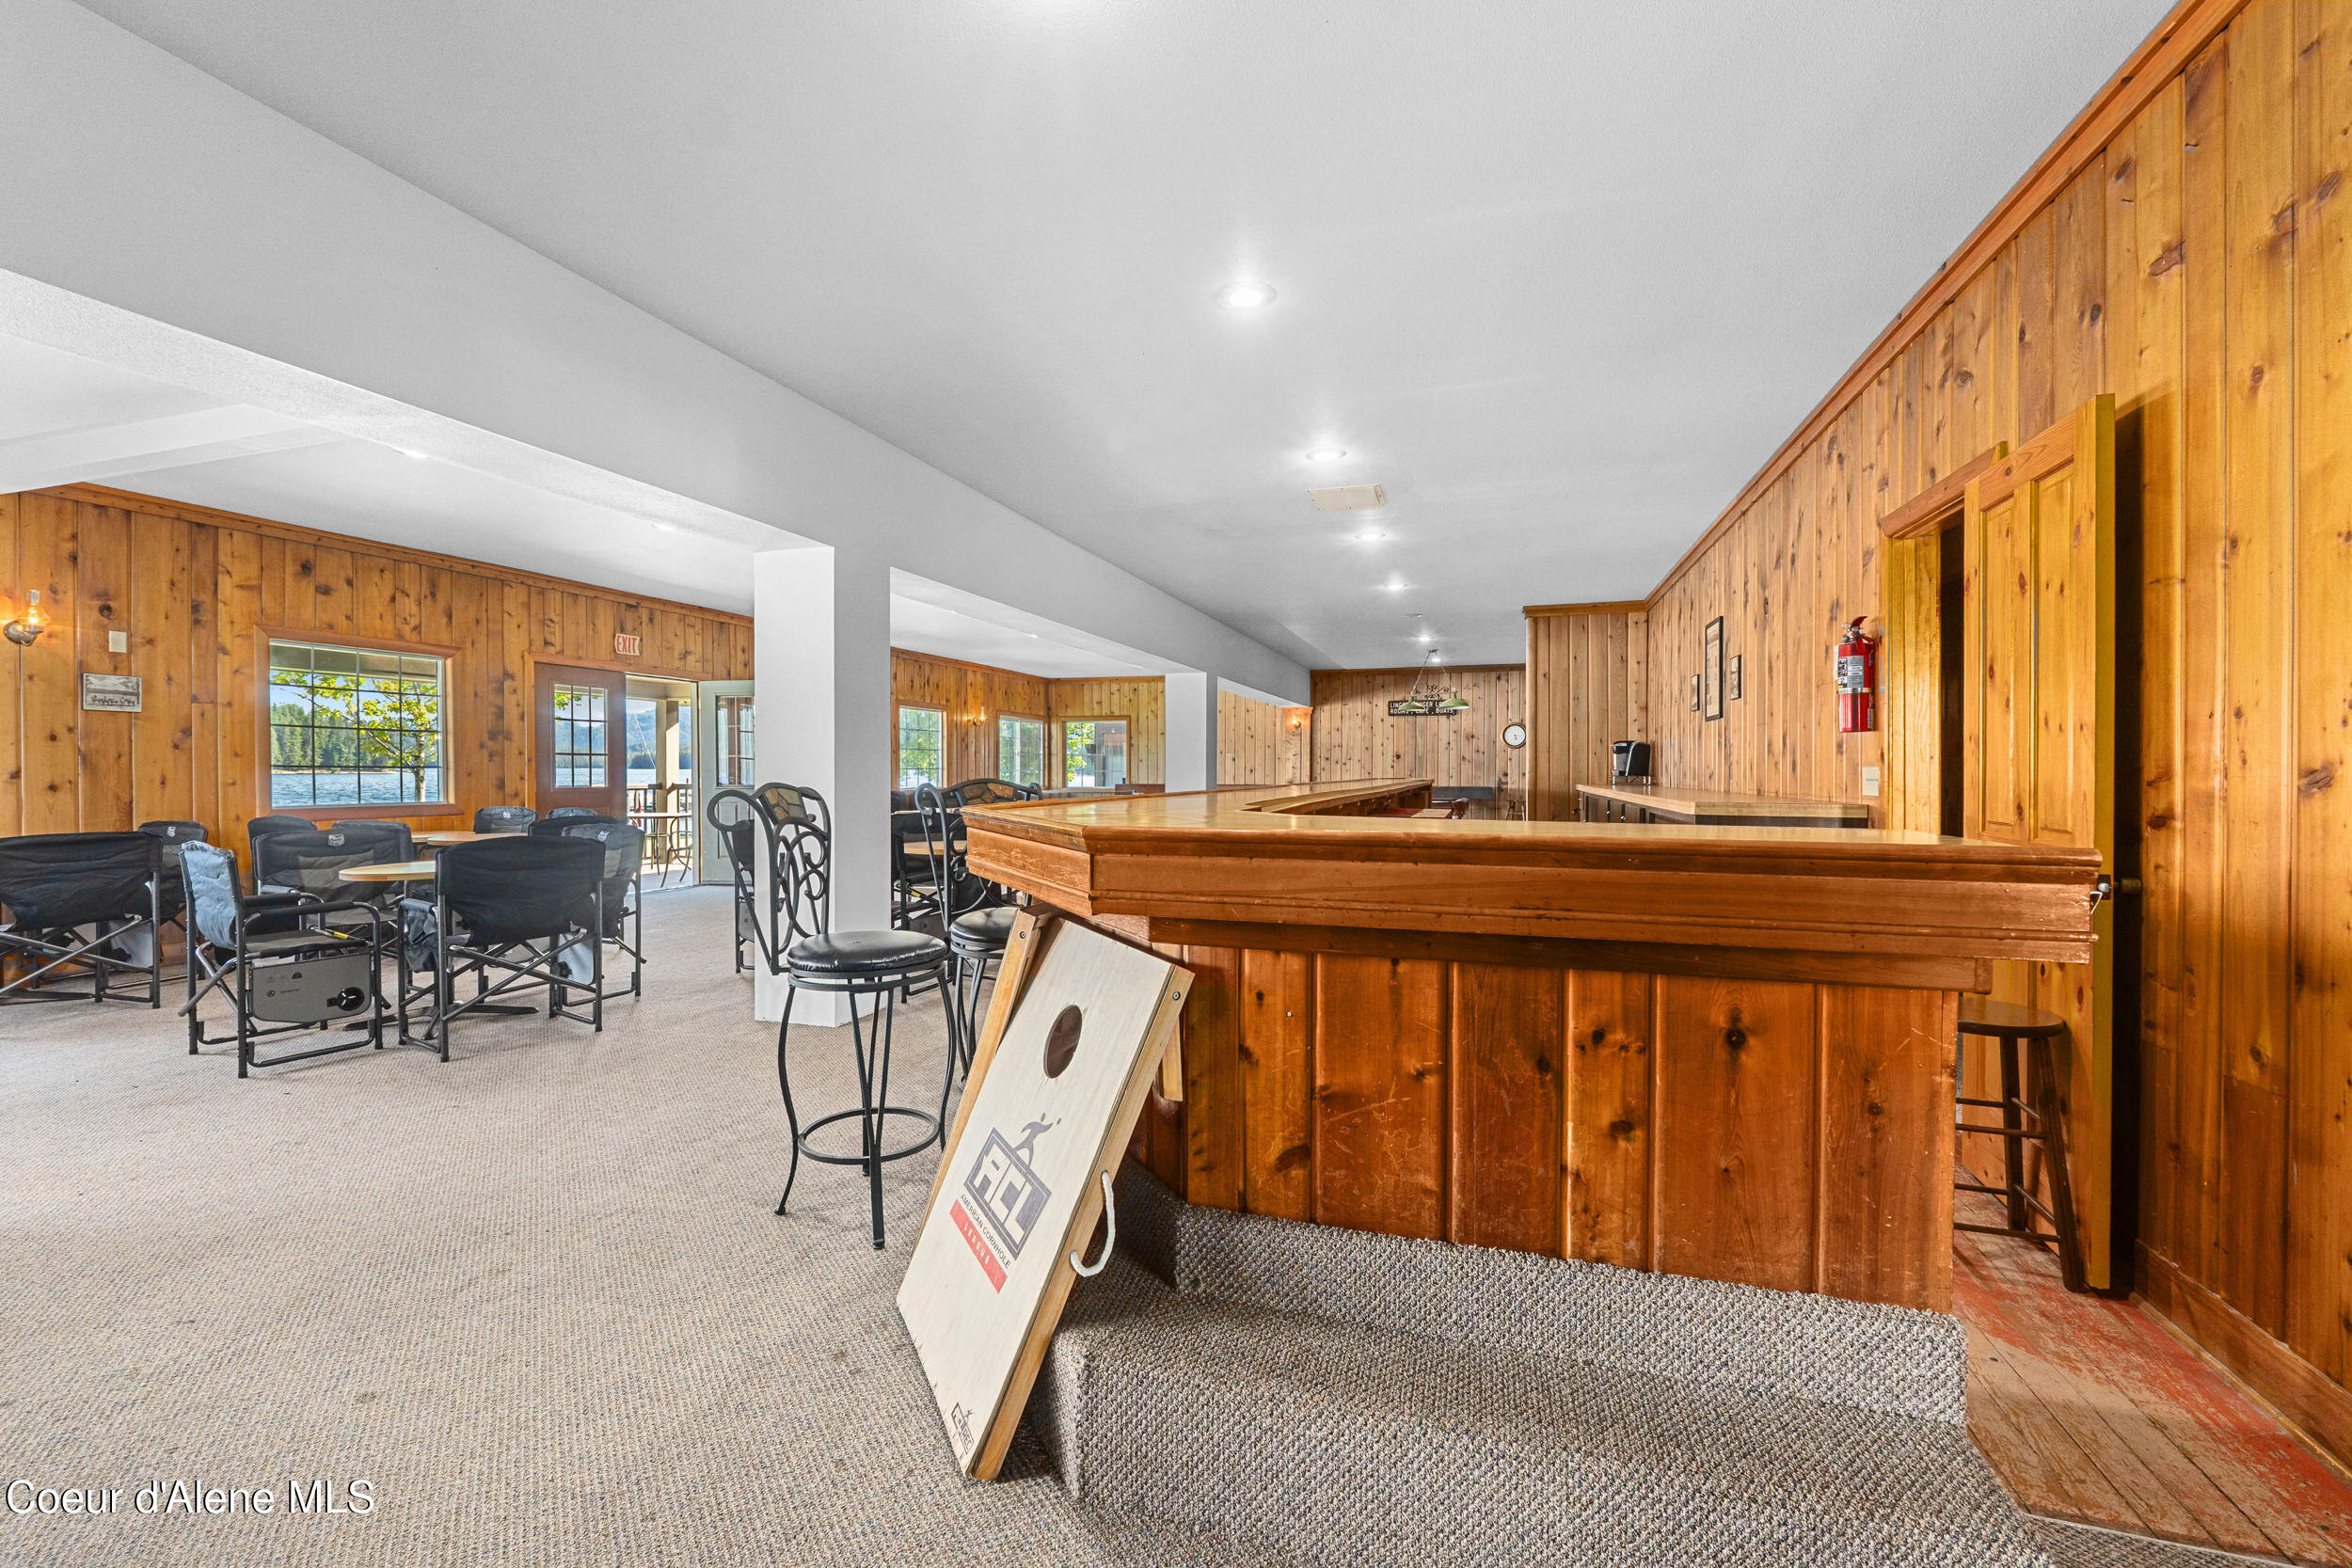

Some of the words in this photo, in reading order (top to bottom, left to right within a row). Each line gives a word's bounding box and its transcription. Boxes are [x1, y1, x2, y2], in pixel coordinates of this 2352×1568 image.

[617, 635, 638, 654] EXIT
[973, 1143, 1033, 1243] ACL
[961, 1194, 984, 1228] AMERICAN
[982, 1226, 1011, 1269] CORNHOLE
[963, 1221, 991, 1265] LEAGUE
